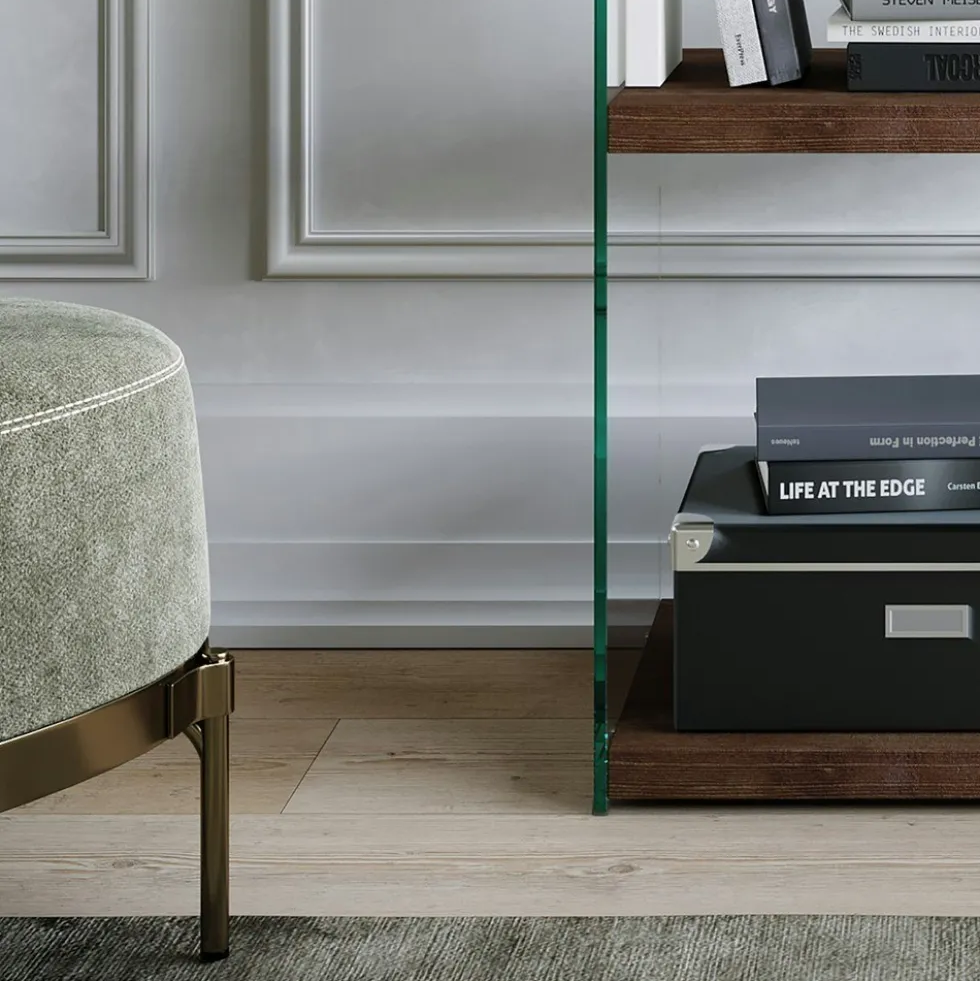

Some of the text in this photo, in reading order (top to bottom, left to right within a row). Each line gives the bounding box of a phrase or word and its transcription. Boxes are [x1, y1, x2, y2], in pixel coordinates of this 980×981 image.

[842, 25, 863, 37] THE
[871, 25, 920, 37] SWEDISH
[869, 437, 900, 449] Form
[903, 436, 914, 448] in
[917, 435, 976, 448] Perfection
[780, 478, 925, 500] LIFE AT THE EDGE
[947, 481, 975, 491] Carsten
